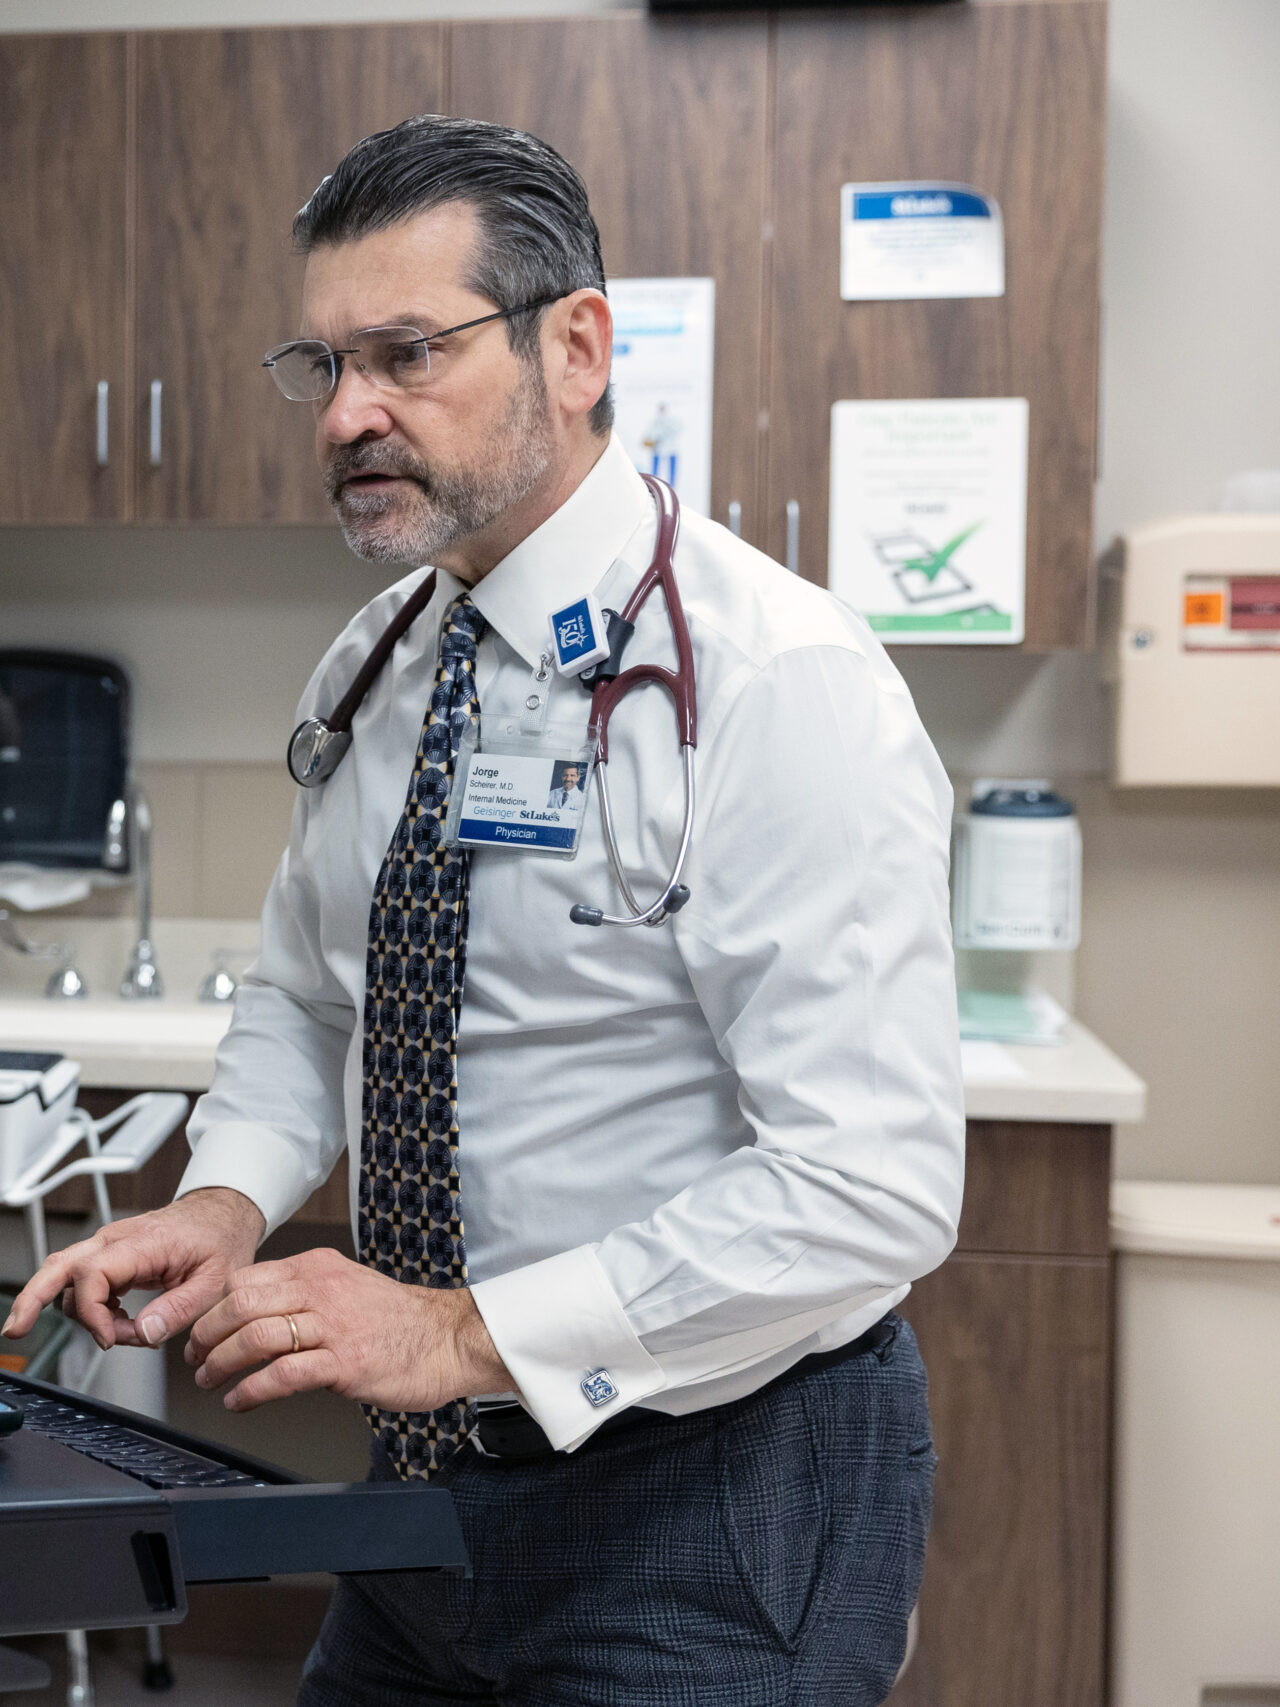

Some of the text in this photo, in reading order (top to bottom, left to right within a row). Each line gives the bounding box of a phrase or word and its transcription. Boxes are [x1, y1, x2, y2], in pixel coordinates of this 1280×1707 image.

[472, 766, 499, 778] Jorge
[468, 793, 528, 807] Internal Medicine
[473, 805, 516, 819] Geisinger
[495, 825, 537, 840] Physician
